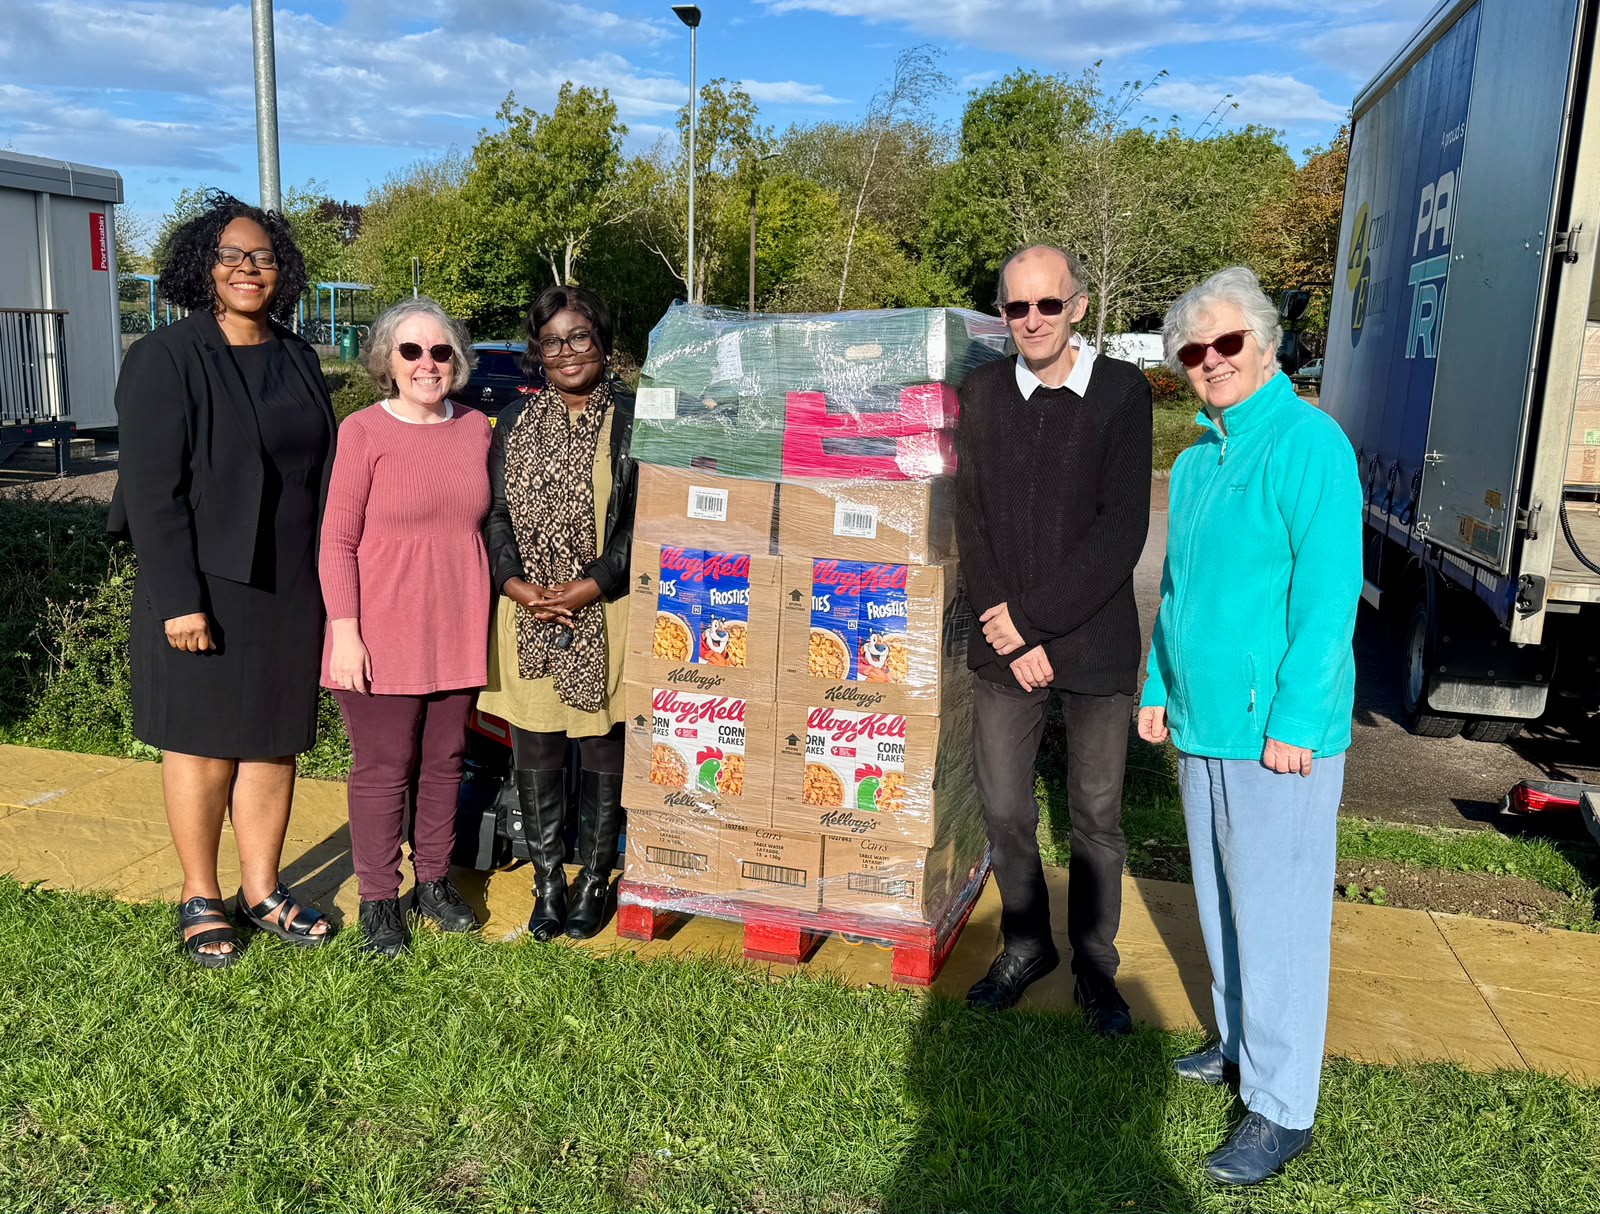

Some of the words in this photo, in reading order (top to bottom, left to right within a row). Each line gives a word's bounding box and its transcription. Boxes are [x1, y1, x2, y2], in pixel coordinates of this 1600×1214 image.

[1412, 168, 1459, 257] PA
[99, 215, 107, 270] Portakabin
[709, 588, 750, 606] FROSTIES
[667, 667, 722, 691] Kellogg's
[824, 685, 883, 708] Kellogg's
[718, 725, 745, 738] CORN
[718, 736, 744, 746] FLAKES
[877, 742, 905, 754] CORN
[877, 753, 905, 763] FLAKES
[820, 810, 876, 833] Kellogg's
[755, 828, 783, 841] Carr's
[860, 839, 888, 852] Carr's
